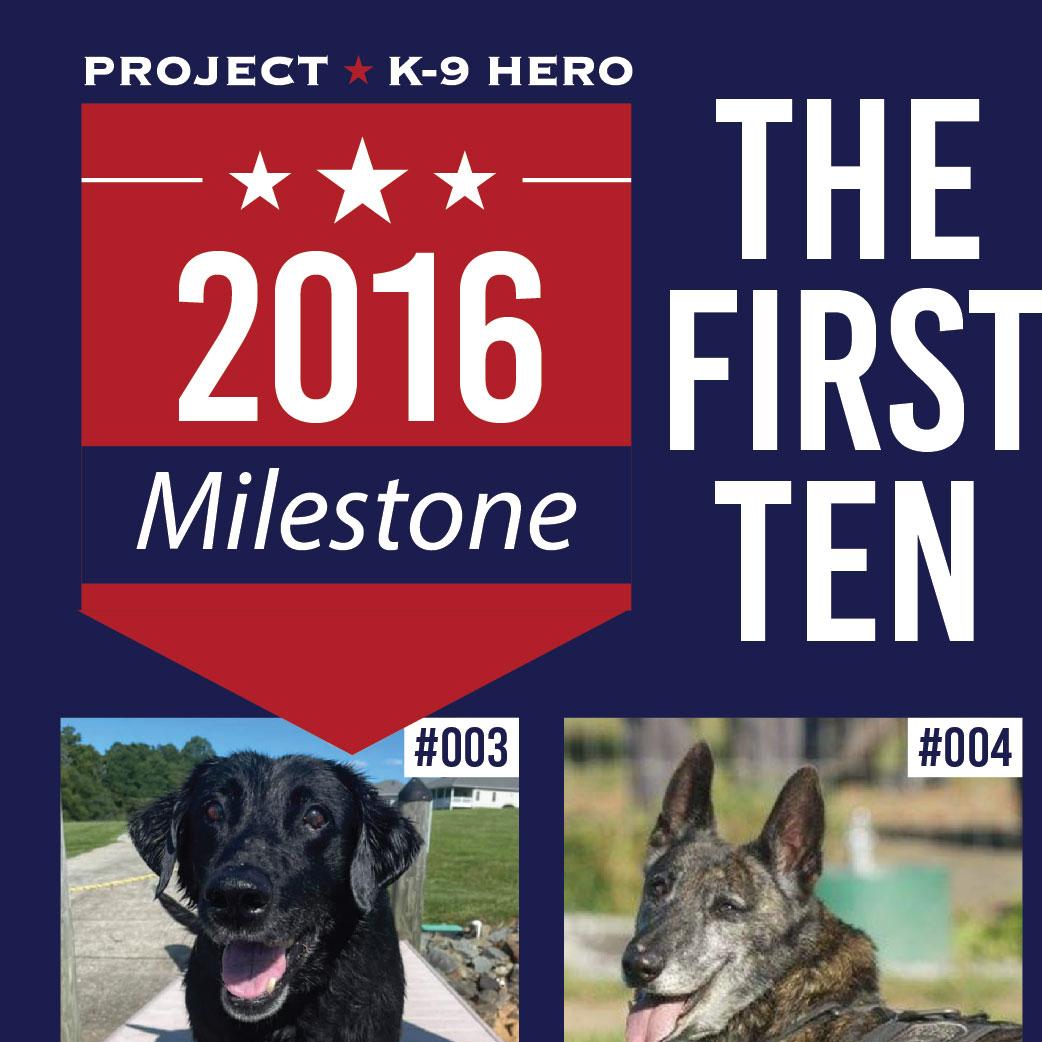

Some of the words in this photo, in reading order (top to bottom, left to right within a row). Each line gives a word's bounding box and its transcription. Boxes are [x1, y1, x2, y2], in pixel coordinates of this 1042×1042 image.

[85, 55, 328, 86] PROJECT
[389, 57, 468, 86] K-9
[489, 56, 633, 86] HERO
[716, 99, 979, 259] THE
[179, 251, 542, 423] 2016
[136, 468, 576, 550] Milestone
[715, 481, 974, 641] TEN
[415, 727, 508, 767] #003
[919, 727, 1012, 767] #004
